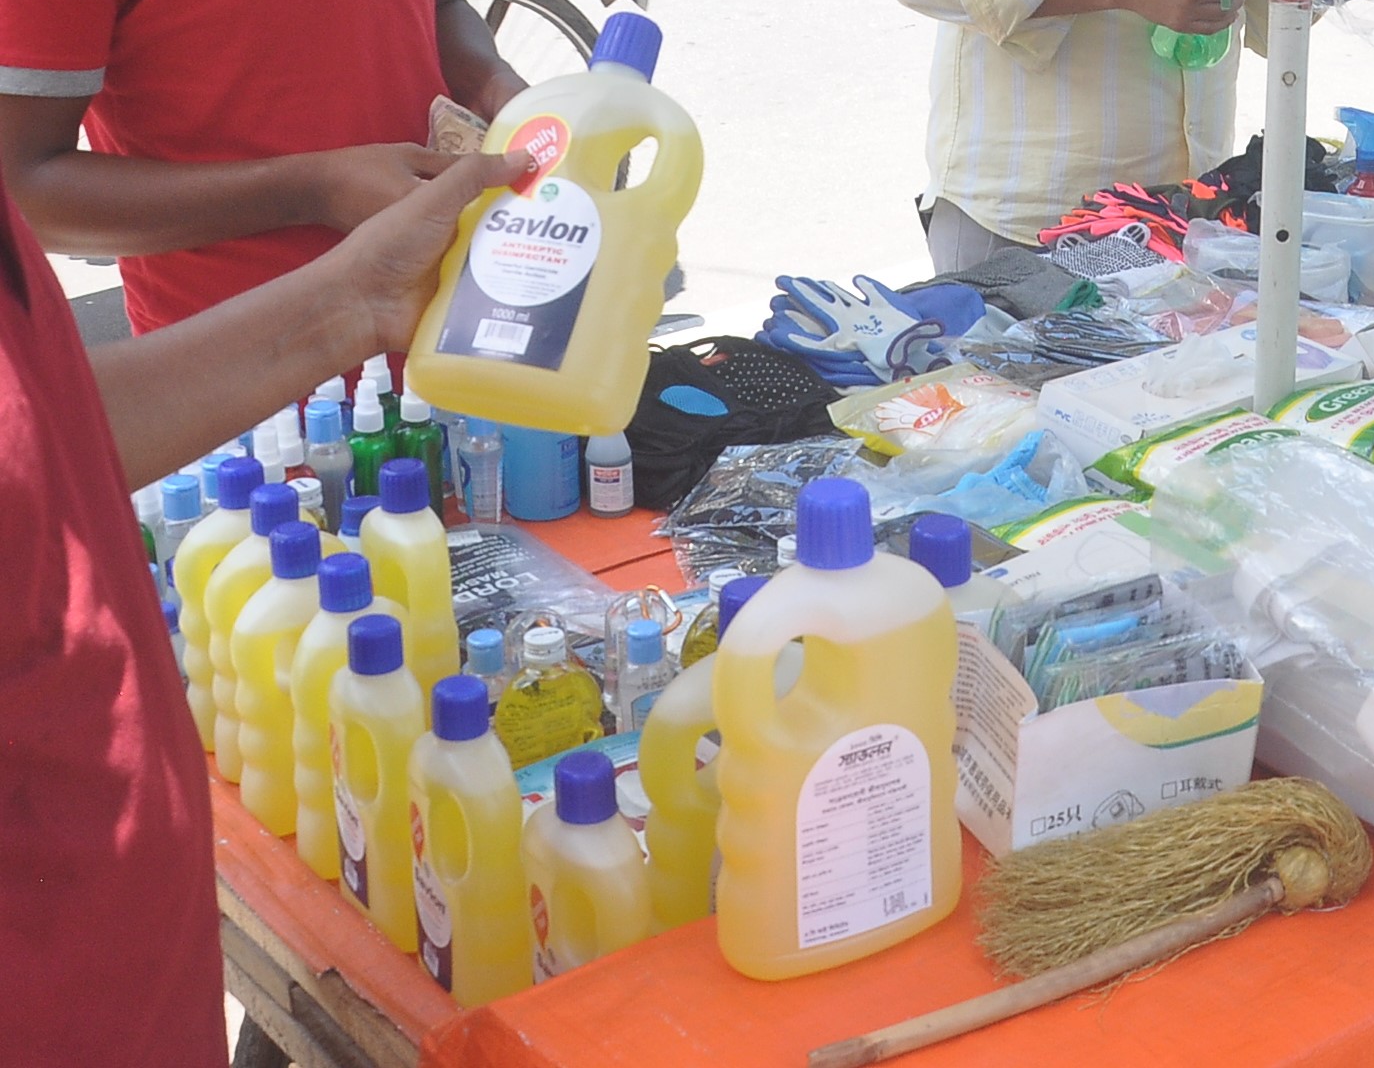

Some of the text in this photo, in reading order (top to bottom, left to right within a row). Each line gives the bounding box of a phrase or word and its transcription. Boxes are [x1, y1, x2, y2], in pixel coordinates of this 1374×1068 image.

[526, 125, 559, 154] mily
[485, 208, 590, 245] Savlon
[501, 240, 564, 257] ANTISEPTIC
[491, 307, 531, 323] 1000 ml
[1054, 408, 1071, 423] PVC
